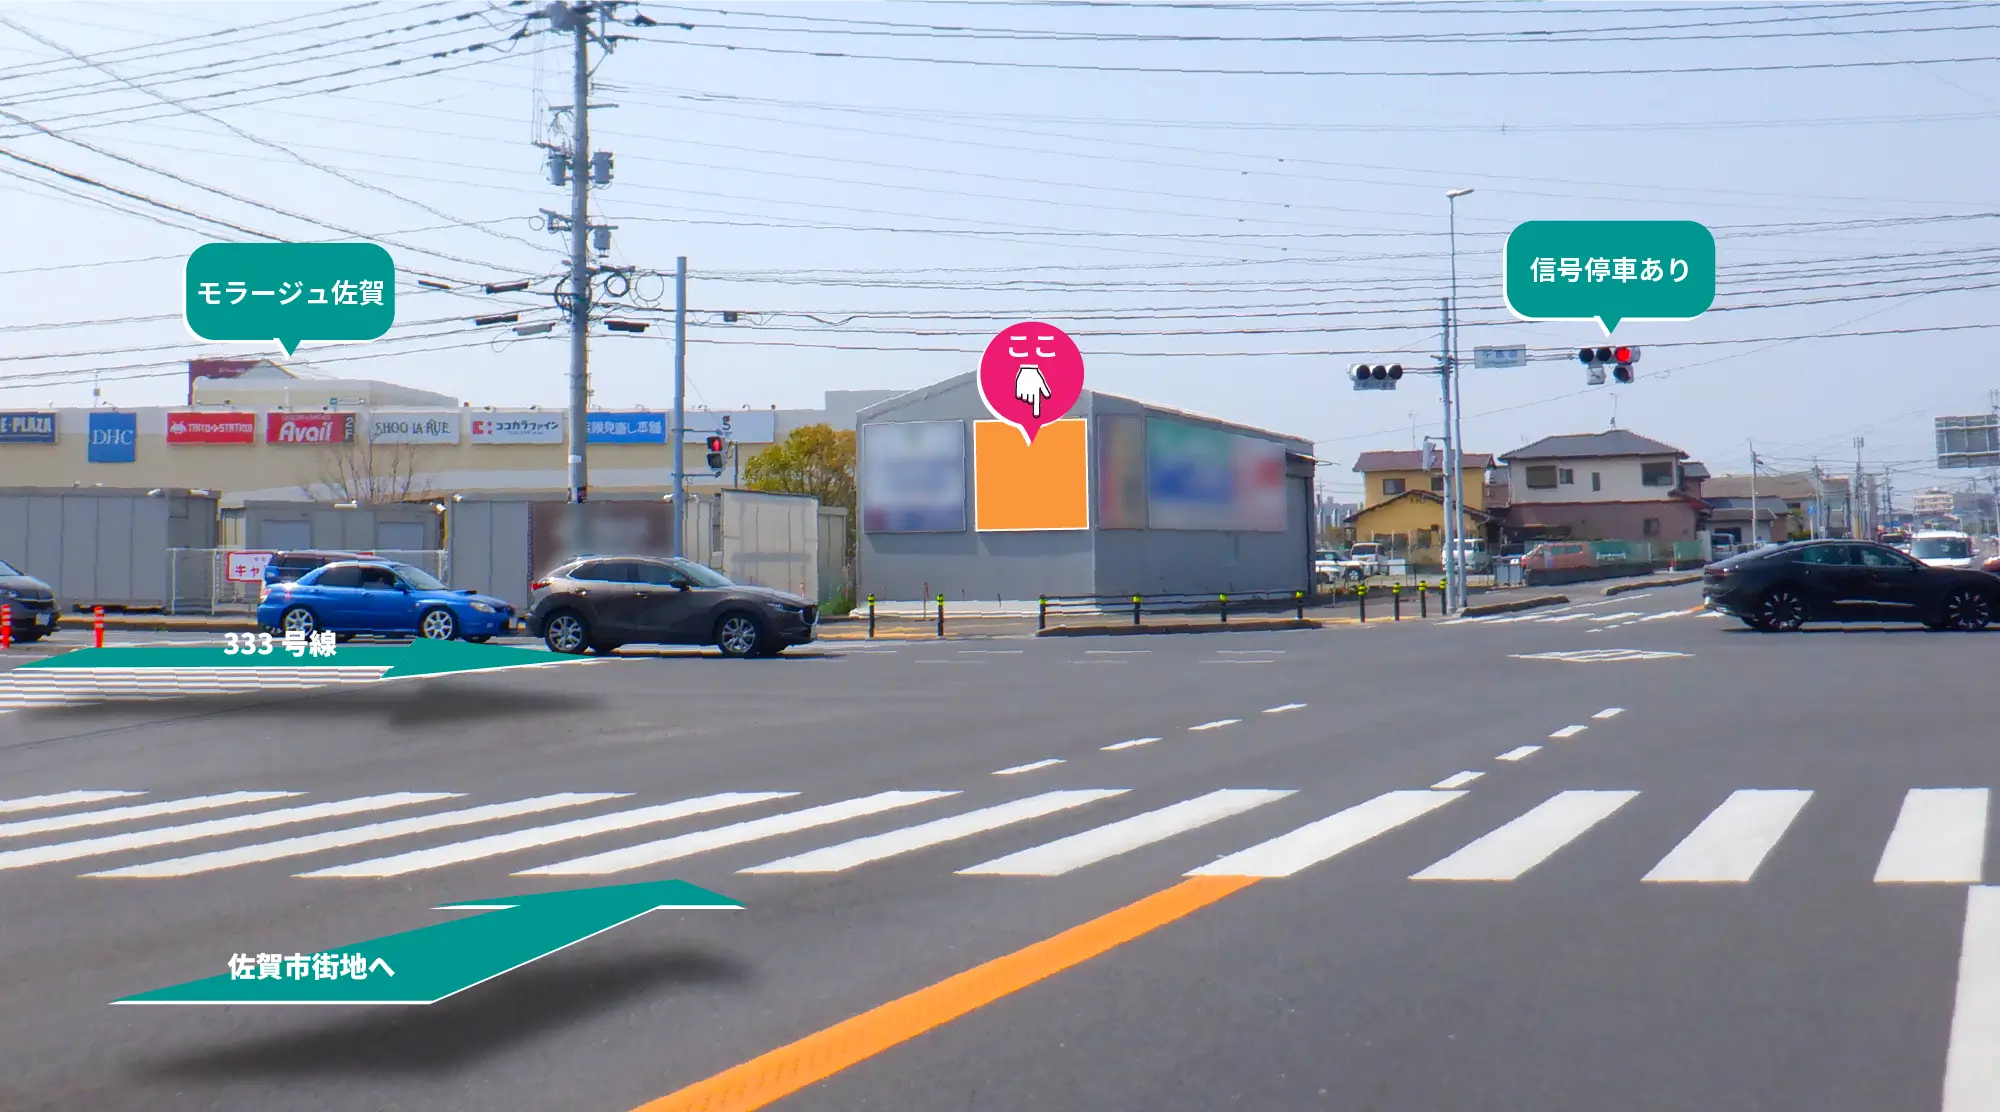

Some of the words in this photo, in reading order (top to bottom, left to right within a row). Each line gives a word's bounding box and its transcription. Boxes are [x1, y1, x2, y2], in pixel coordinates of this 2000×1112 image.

[279, 421, 333, 442] Avail
[496, 419, 559, 430] ココカラファイン
[92, 429, 134, 445] DHC
